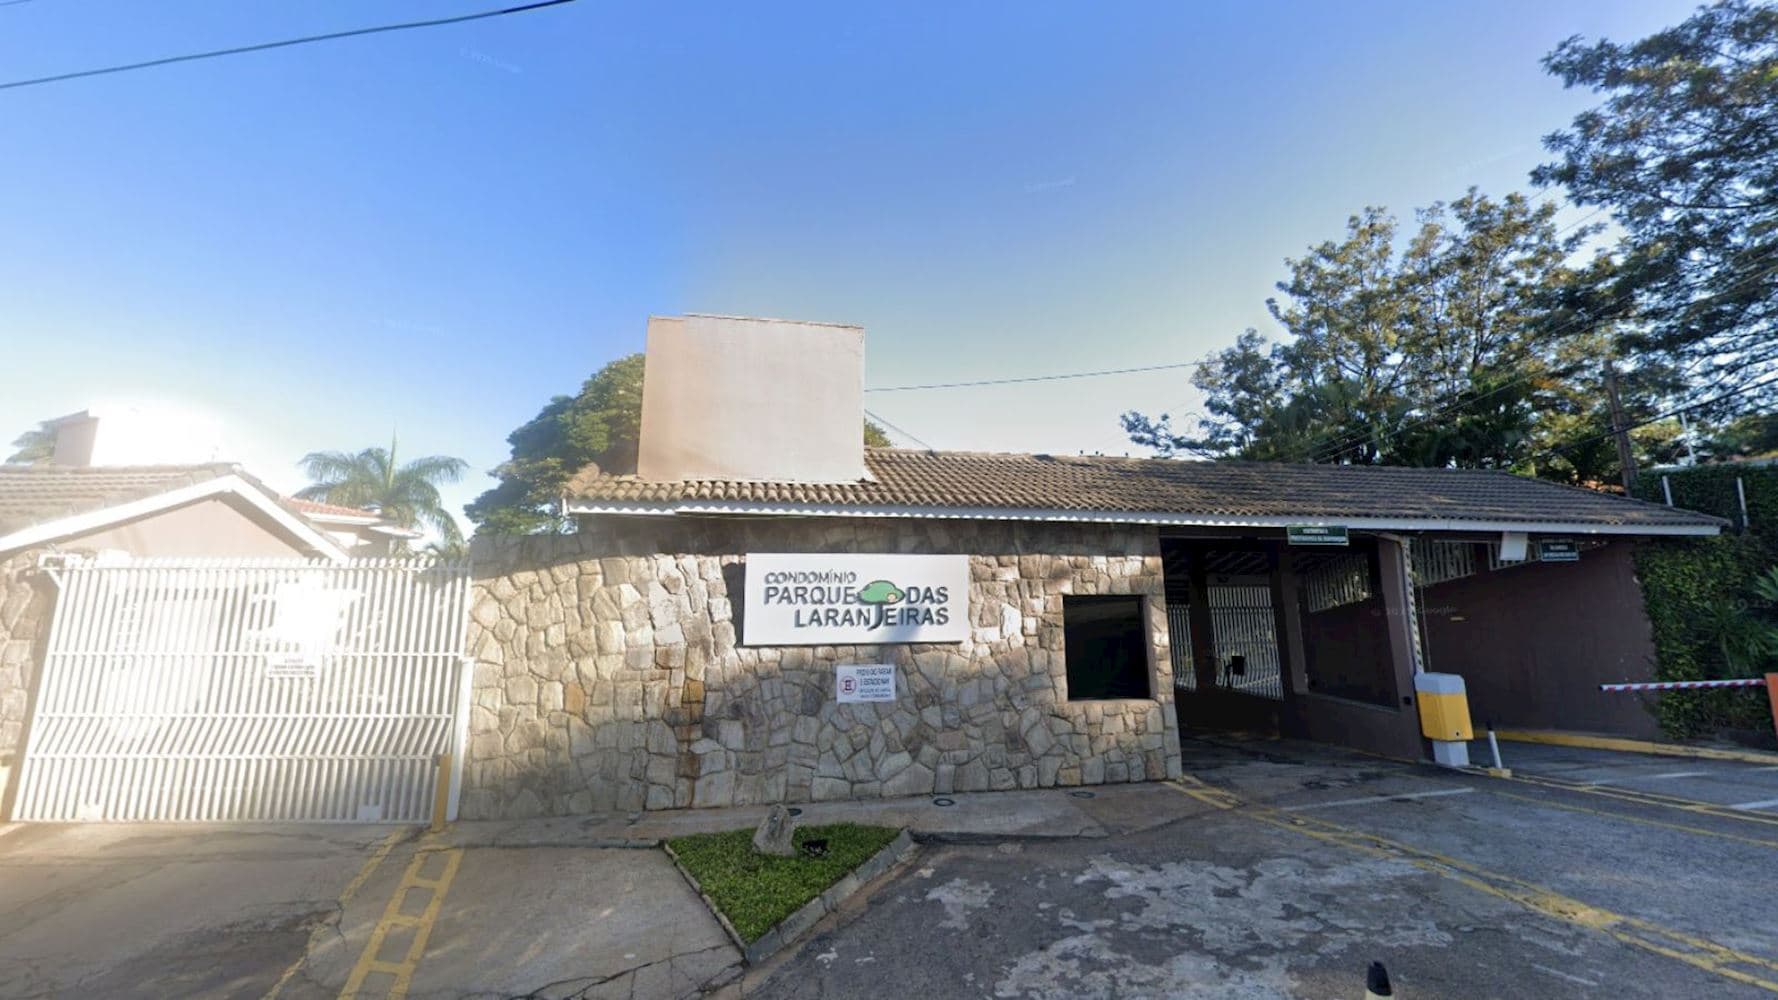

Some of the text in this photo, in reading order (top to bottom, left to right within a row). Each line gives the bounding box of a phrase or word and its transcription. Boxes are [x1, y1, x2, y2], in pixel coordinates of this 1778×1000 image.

[764, 569, 857, 585] CONDOMÍNIO
[763, 586, 949, 605] PARQUE DAS
[794, 607, 949, 631] LARANJEIRAS
